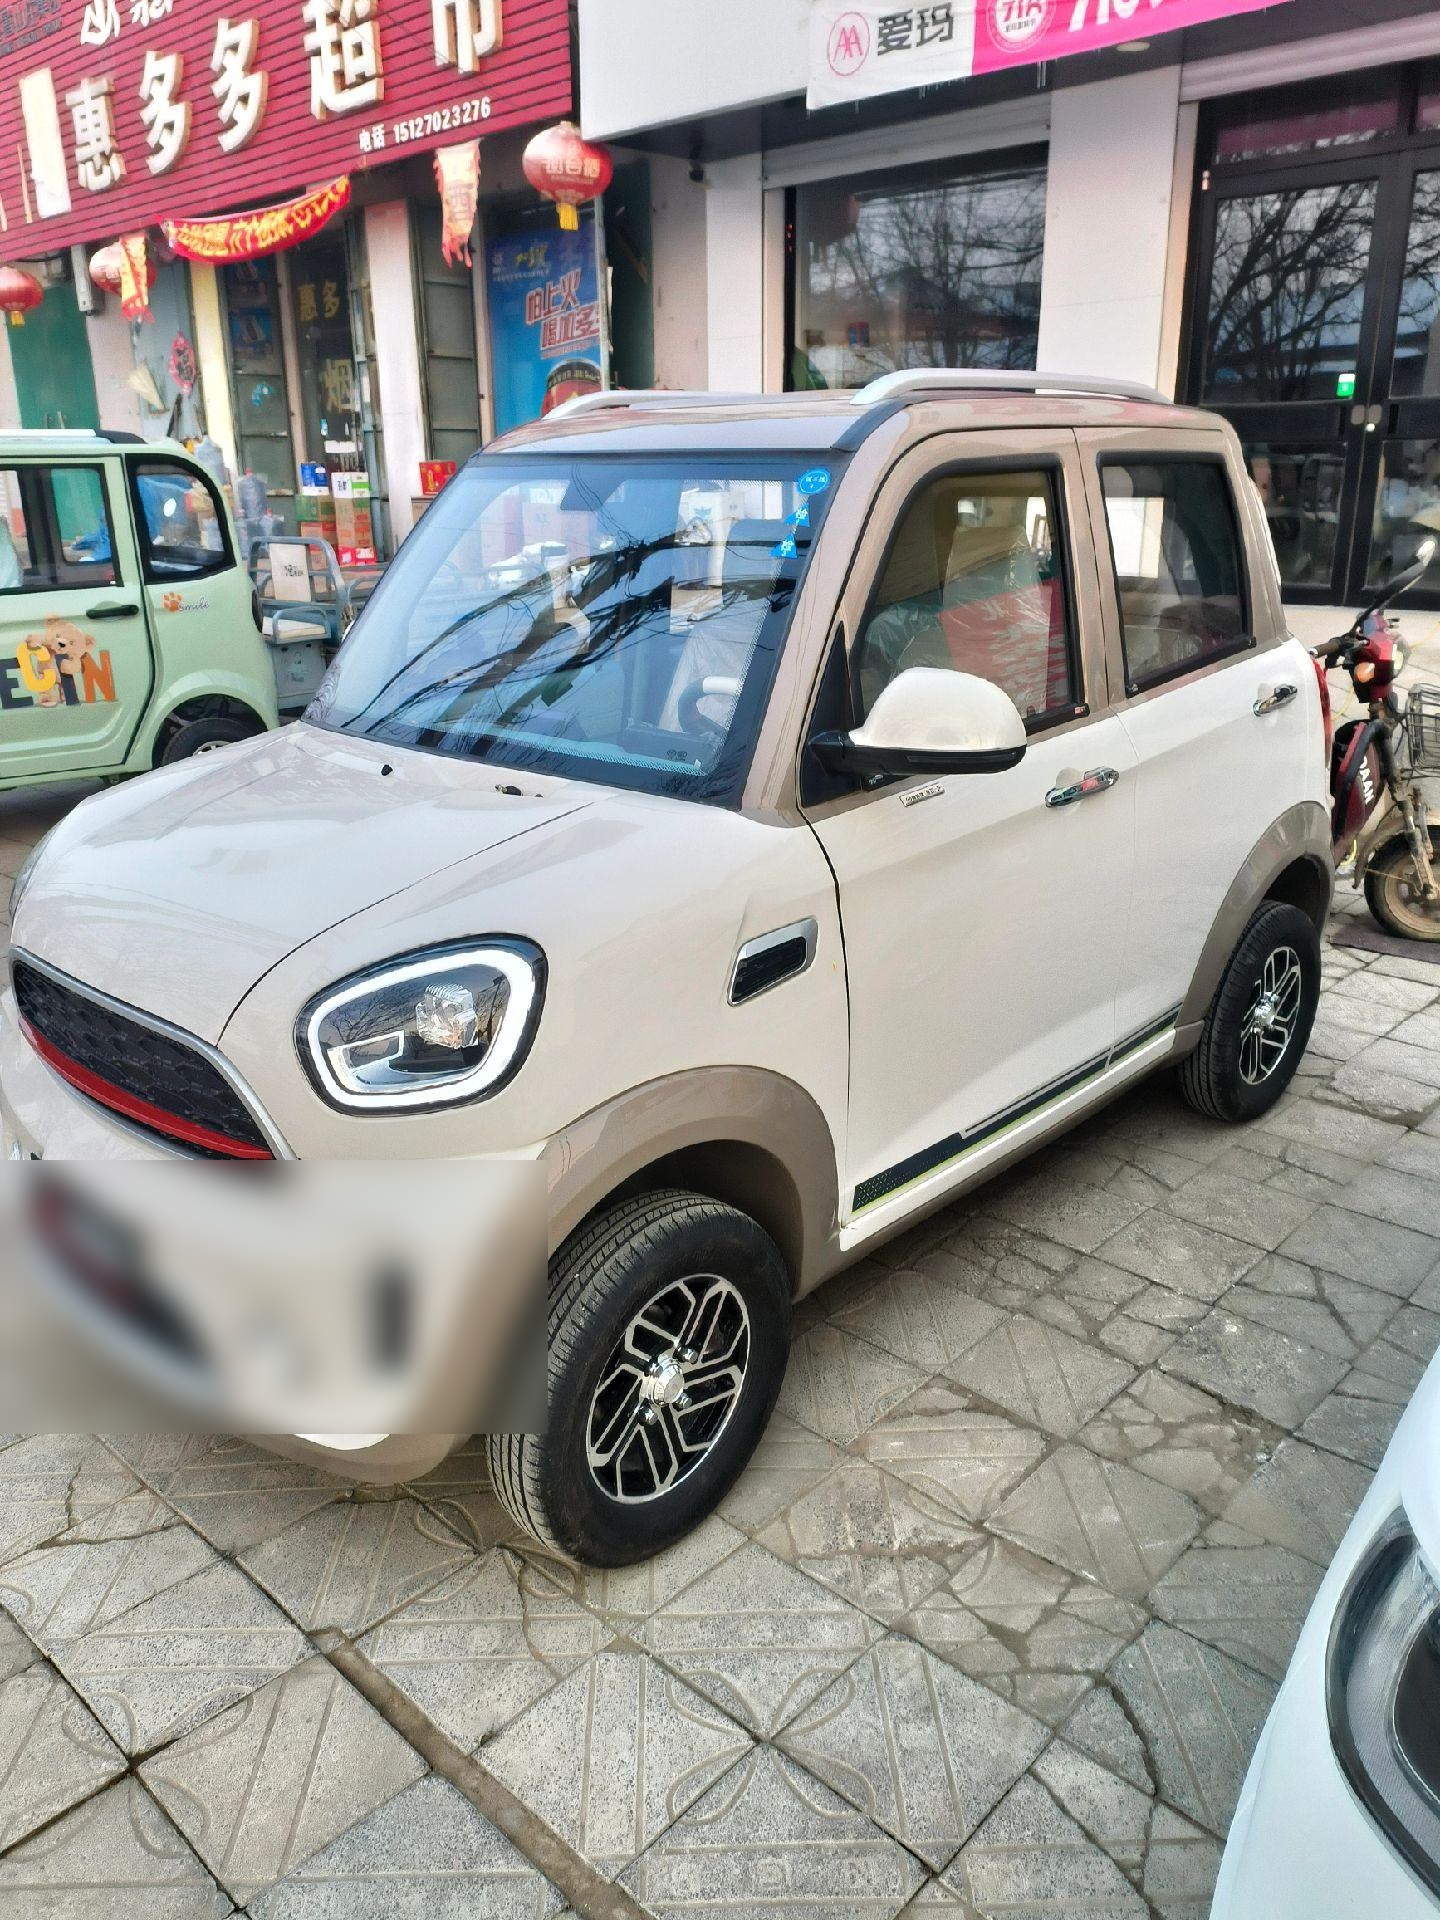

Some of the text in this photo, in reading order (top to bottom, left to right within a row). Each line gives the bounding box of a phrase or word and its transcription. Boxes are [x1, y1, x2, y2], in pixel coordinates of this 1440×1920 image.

[877, 2, 954, 56] 爱玛
[359, 96, 491, 152] 电话 15127023276
